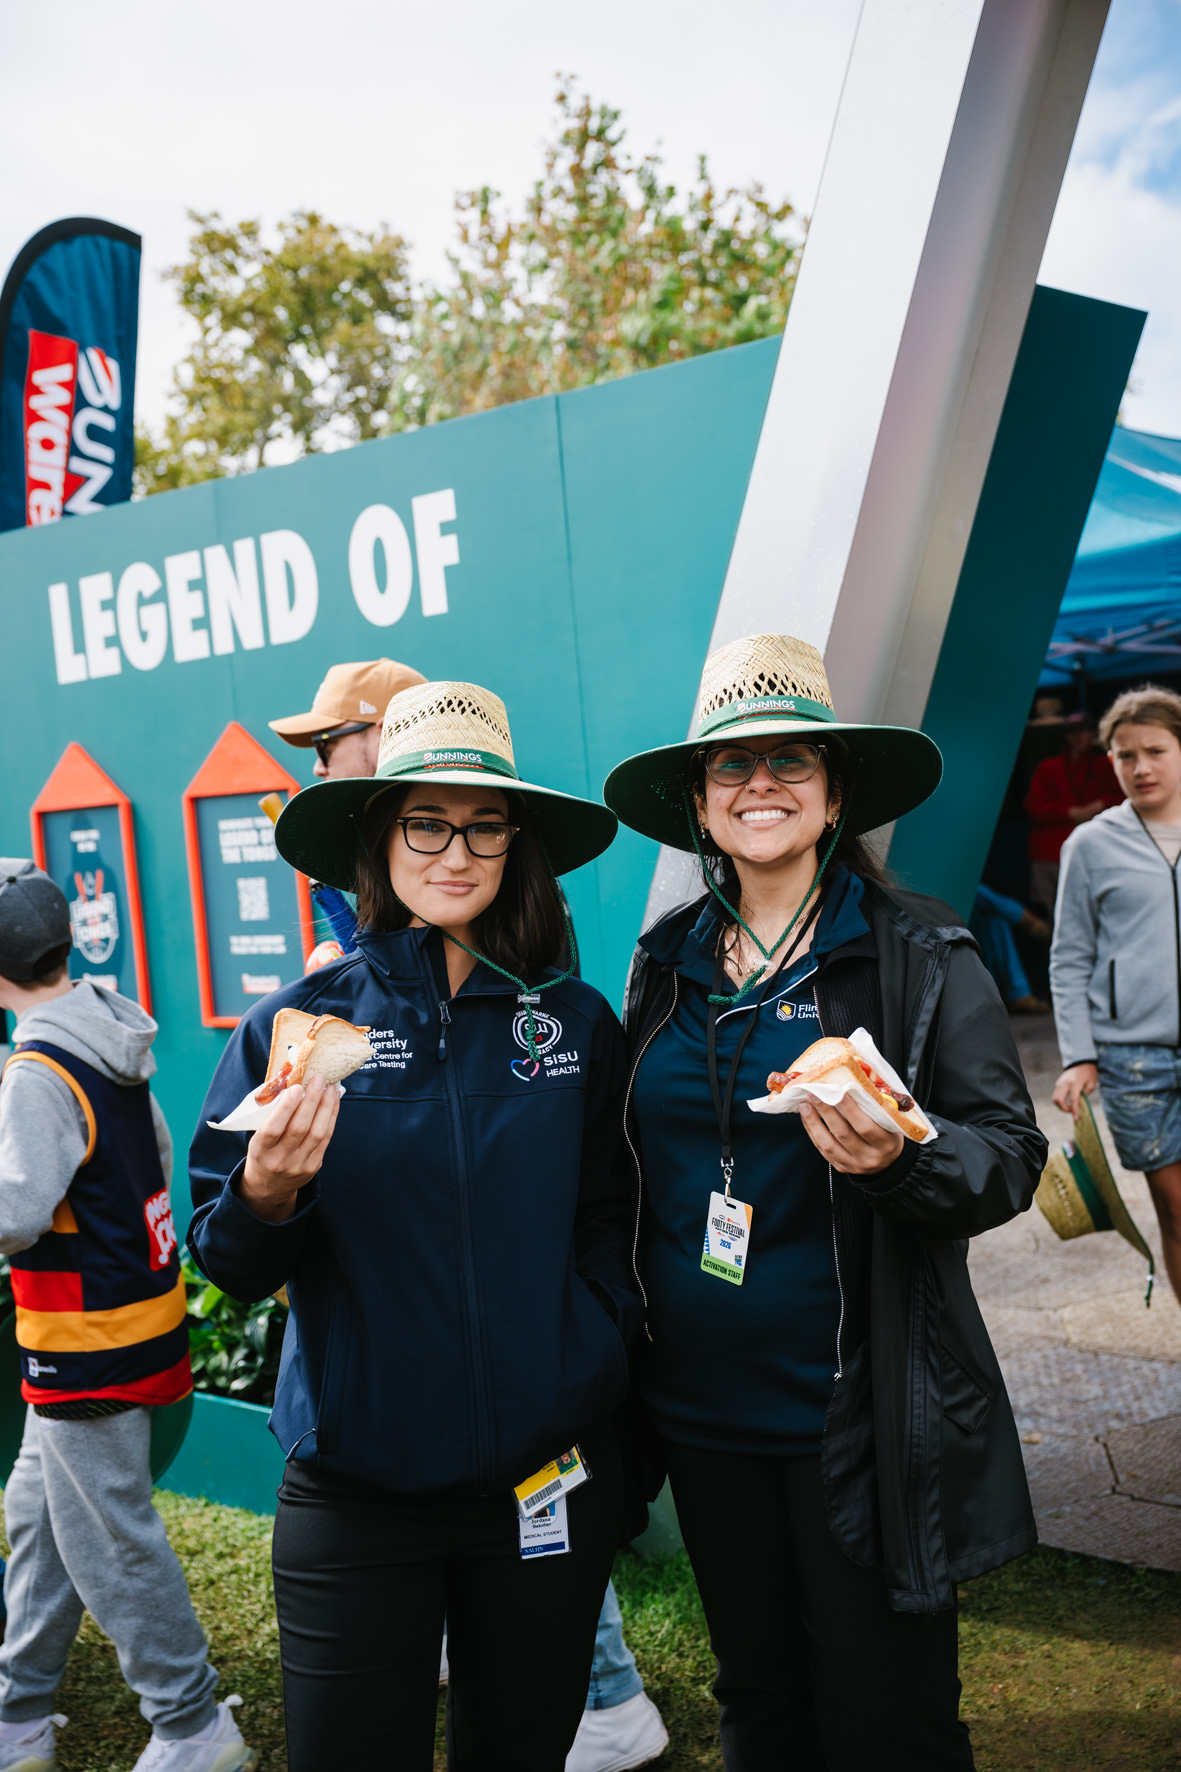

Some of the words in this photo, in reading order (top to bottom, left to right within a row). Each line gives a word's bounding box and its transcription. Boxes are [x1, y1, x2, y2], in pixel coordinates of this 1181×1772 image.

[48, 529, 319, 685] LEGEND
[348, 488, 460, 627] OF
[737, 699, 795, 712] BUNNINGS
[423, 751, 482, 762] BUNNINGS
[401, 1051, 413, 1059] for
[378, 1060, 406, 1069] Testing
[546, 1065, 580, 1077] HEALTH
[726, 1222, 745, 1238] FESTIVAL
[703, 1259, 727, 1274] ACTIVATION
[728, 1269, 741, 1280] STAFF
